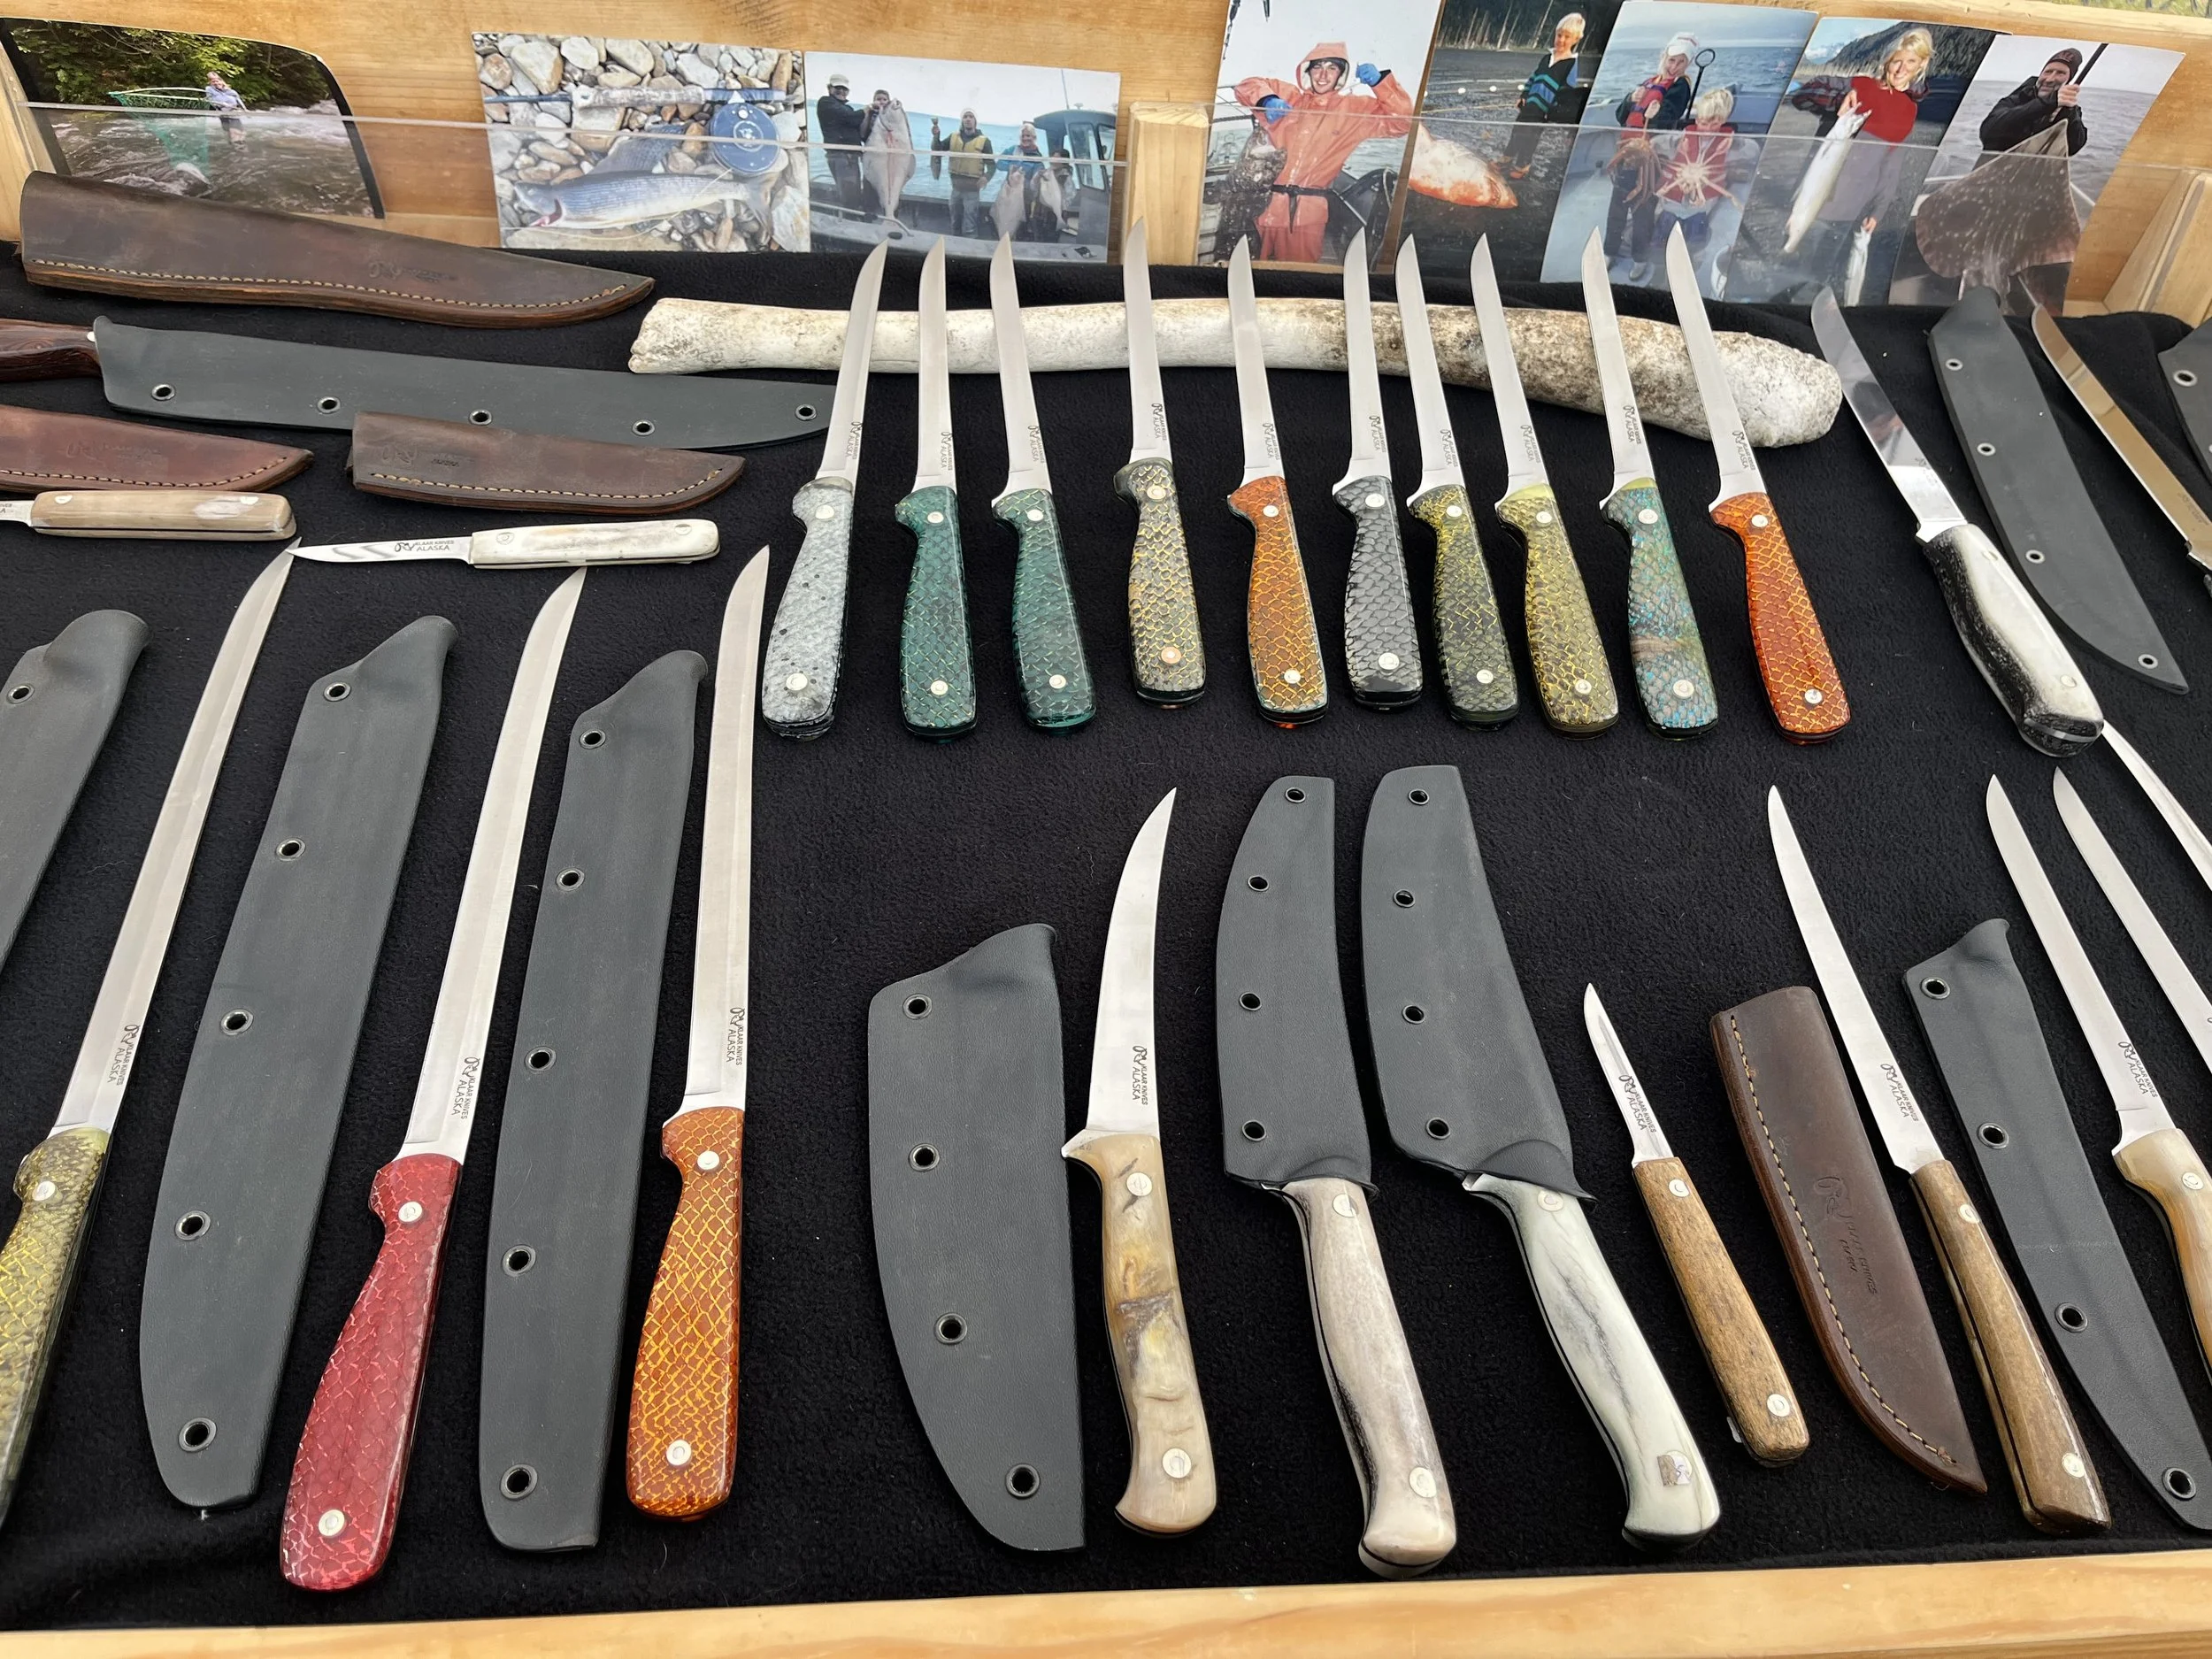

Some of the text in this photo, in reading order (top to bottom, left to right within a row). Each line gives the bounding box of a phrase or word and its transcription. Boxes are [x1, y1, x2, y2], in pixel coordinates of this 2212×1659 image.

[1265, 437, 1274, 458] ALASKA
[1625, 419, 1634, 442] ALASKA
[1737, 446, 1748, 468] ALASKA
[726, 1029, 736, 1063] ALASKA
[107, 1048, 125, 1083] ALASKA
[2128, 1062, 2148, 1094] ALASKA
[2135, 1060, 2159, 1097] KLAAR KNIVES
[451, 1079, 467, 1116] ALASKA
[460, 1097, 471, 1120] KNIVES
[1627, 1097, 1647, 1131] ALASKA
[1634, 1094, 1657, 1133] KLAAR KNIVES
[1890, 1085, 1909, 1118] ALASKA
[1896, 1081, 1919, 1122] KLAAR KNIVES
